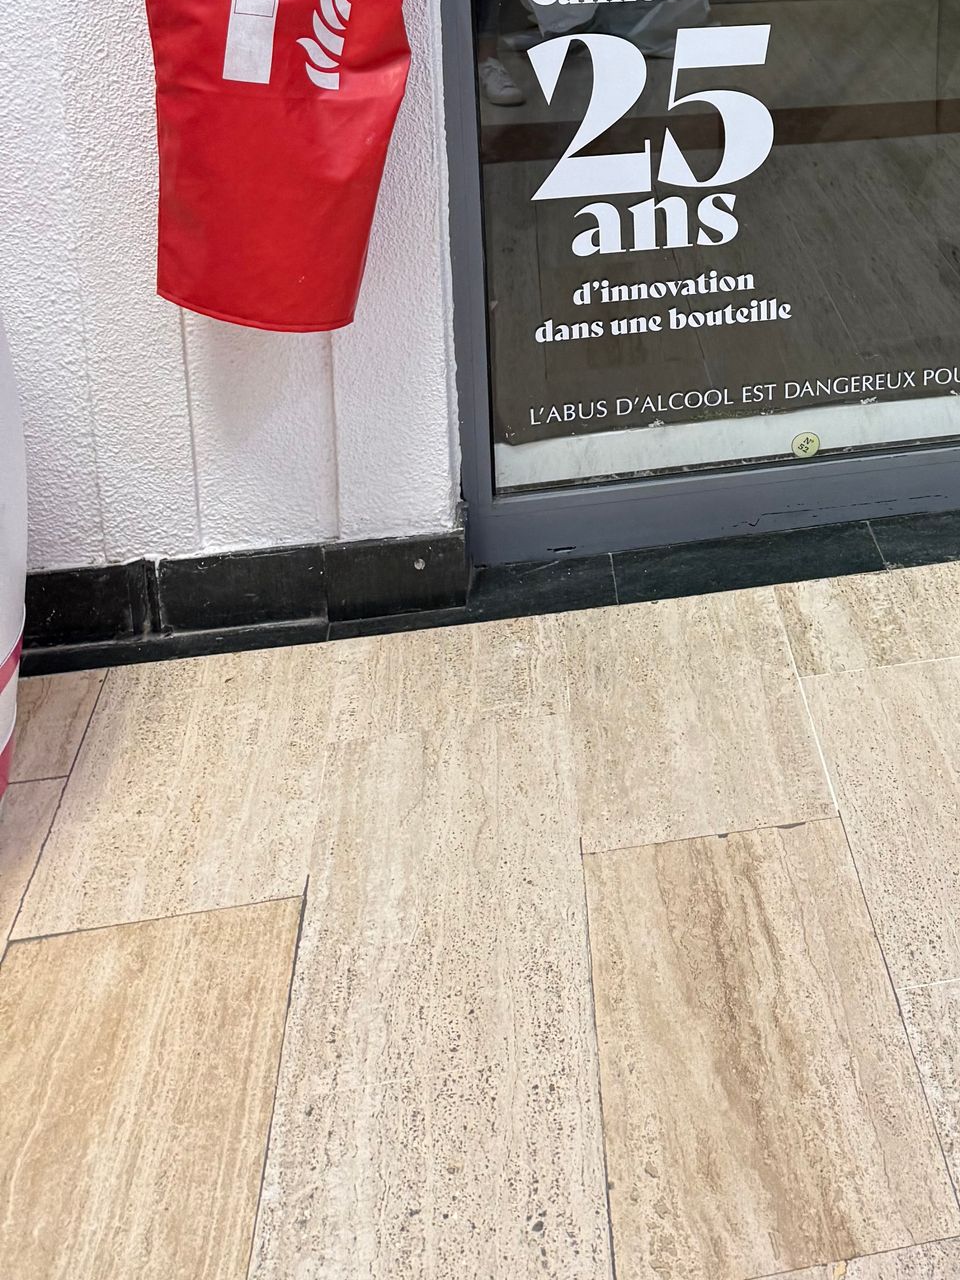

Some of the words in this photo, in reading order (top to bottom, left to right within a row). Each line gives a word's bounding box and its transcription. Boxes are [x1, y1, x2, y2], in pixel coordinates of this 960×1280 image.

[527, 24, 775, 200] 25
[571, 192, 739, 257] ans
[535, 319, 604, 343] dans
[611, 316, 663, 336] une
[668, 297, 792, 331] bouteille
[742, 383, 777, 403] EST
[784, 371, 916, 399] DANGEREUX
